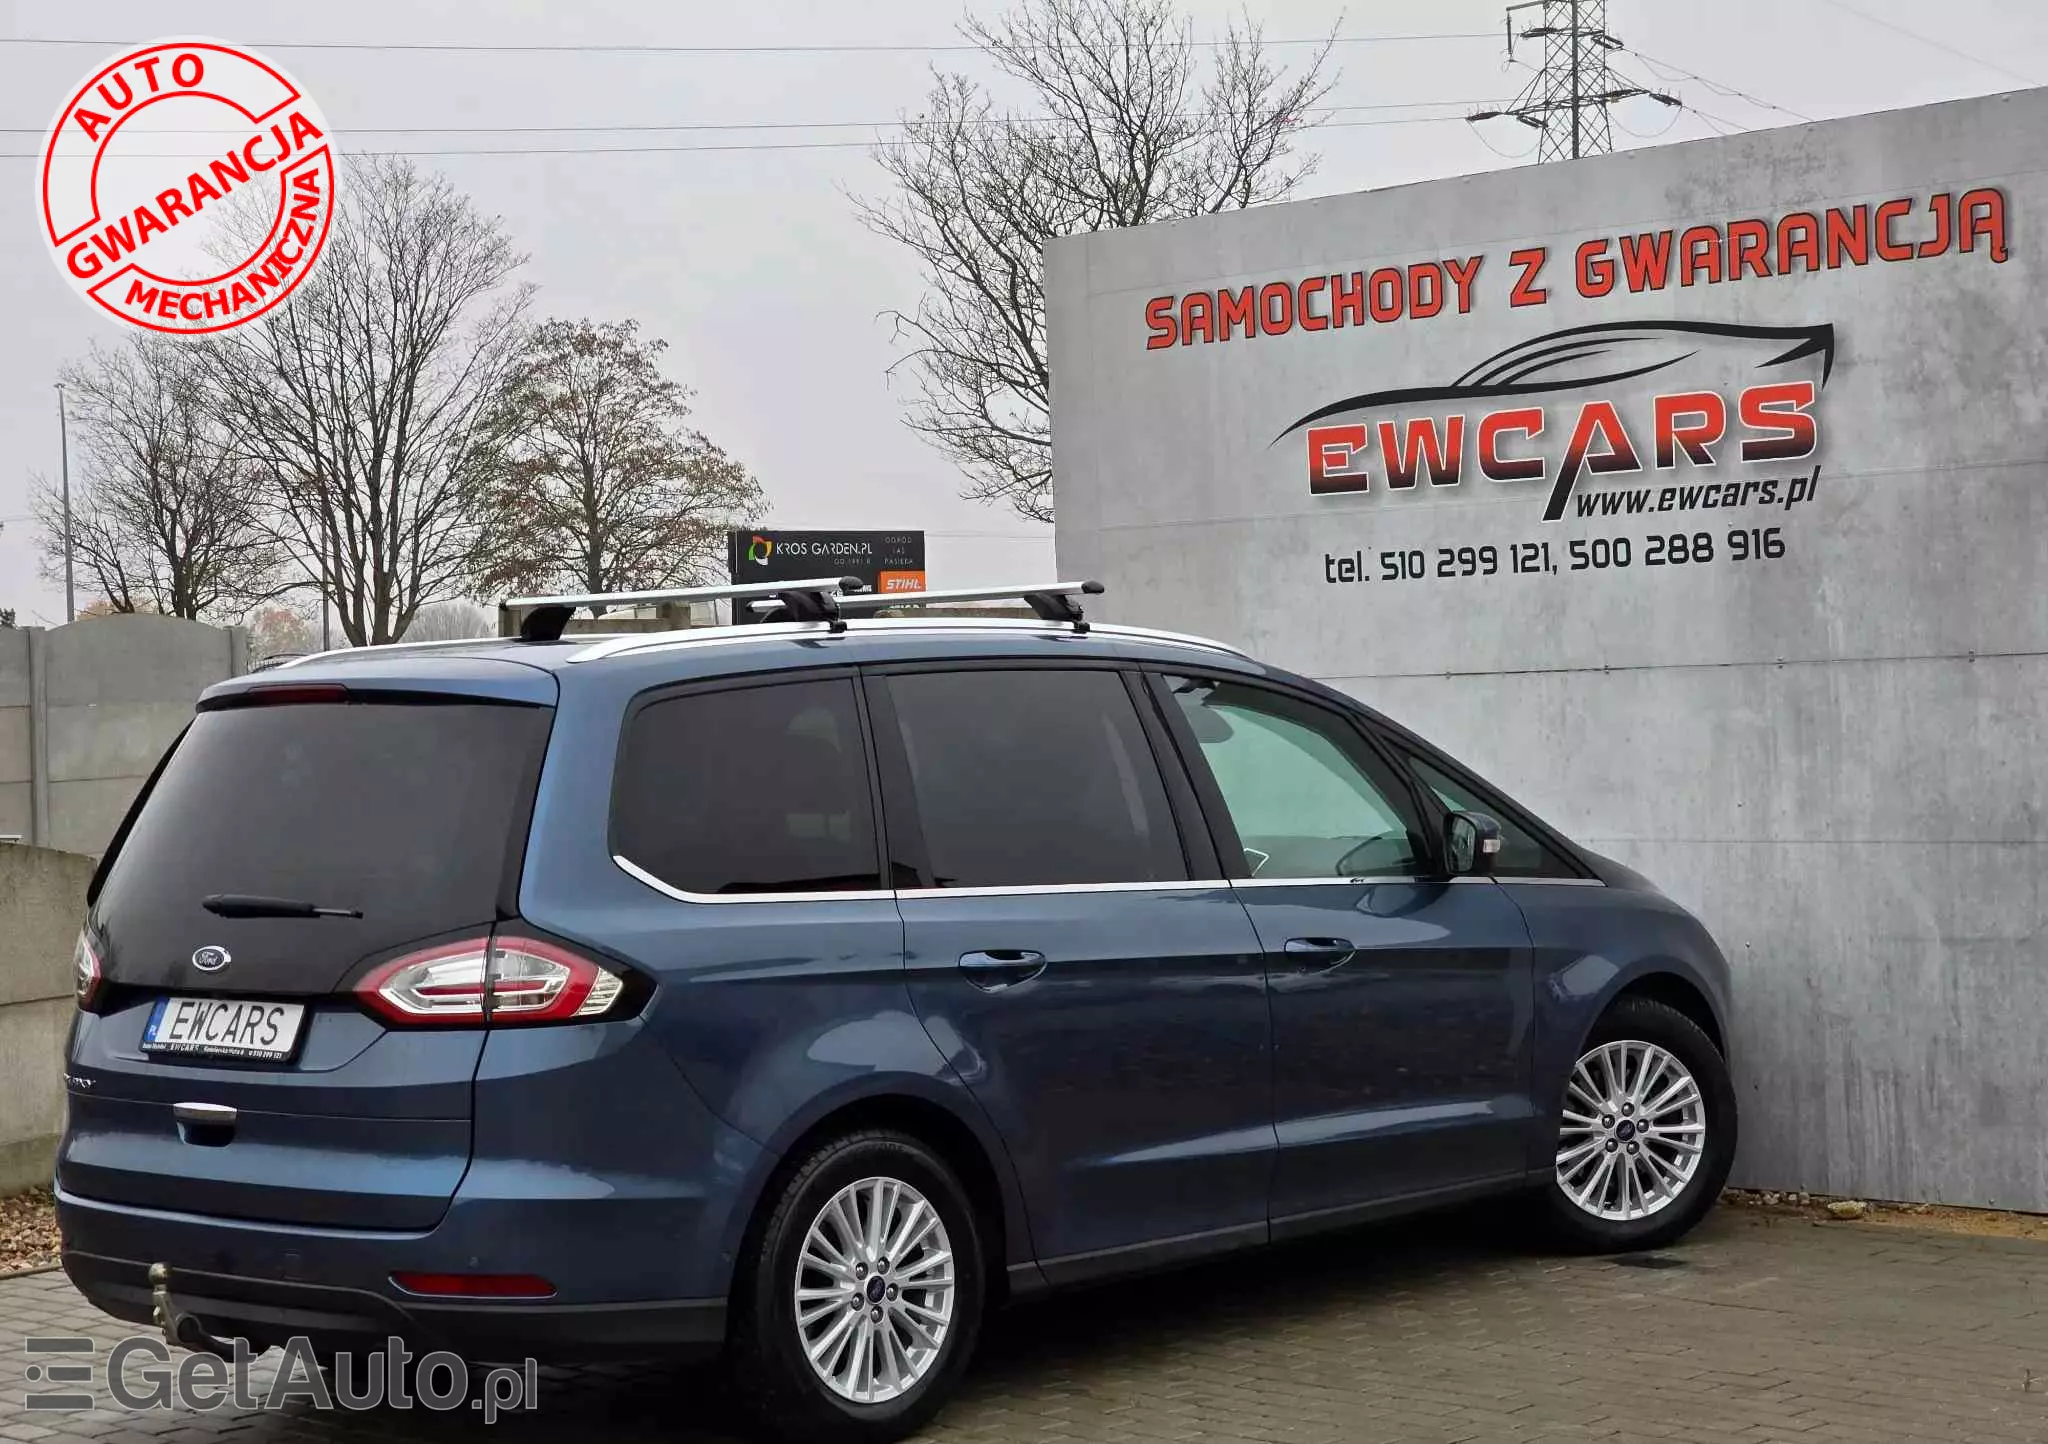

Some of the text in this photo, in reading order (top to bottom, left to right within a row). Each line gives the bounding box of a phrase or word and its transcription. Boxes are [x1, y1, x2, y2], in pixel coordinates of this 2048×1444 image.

[1145, 187, 2009, 350] SAMOCHODY Z GWARANCJĄ
[1306, 380, 1818, 524] EWCARS
[1576, 464, 1822, 518] www.ewcars.pl
[776, 542, 873, 555] KROS GARDEN.PL
[1325, 527, 1786, 583] tel. 510 299 121, 500 288 916
[886, 577, 919, 591] STIHL
[169, 1001, 285, 1046] EWCARS
